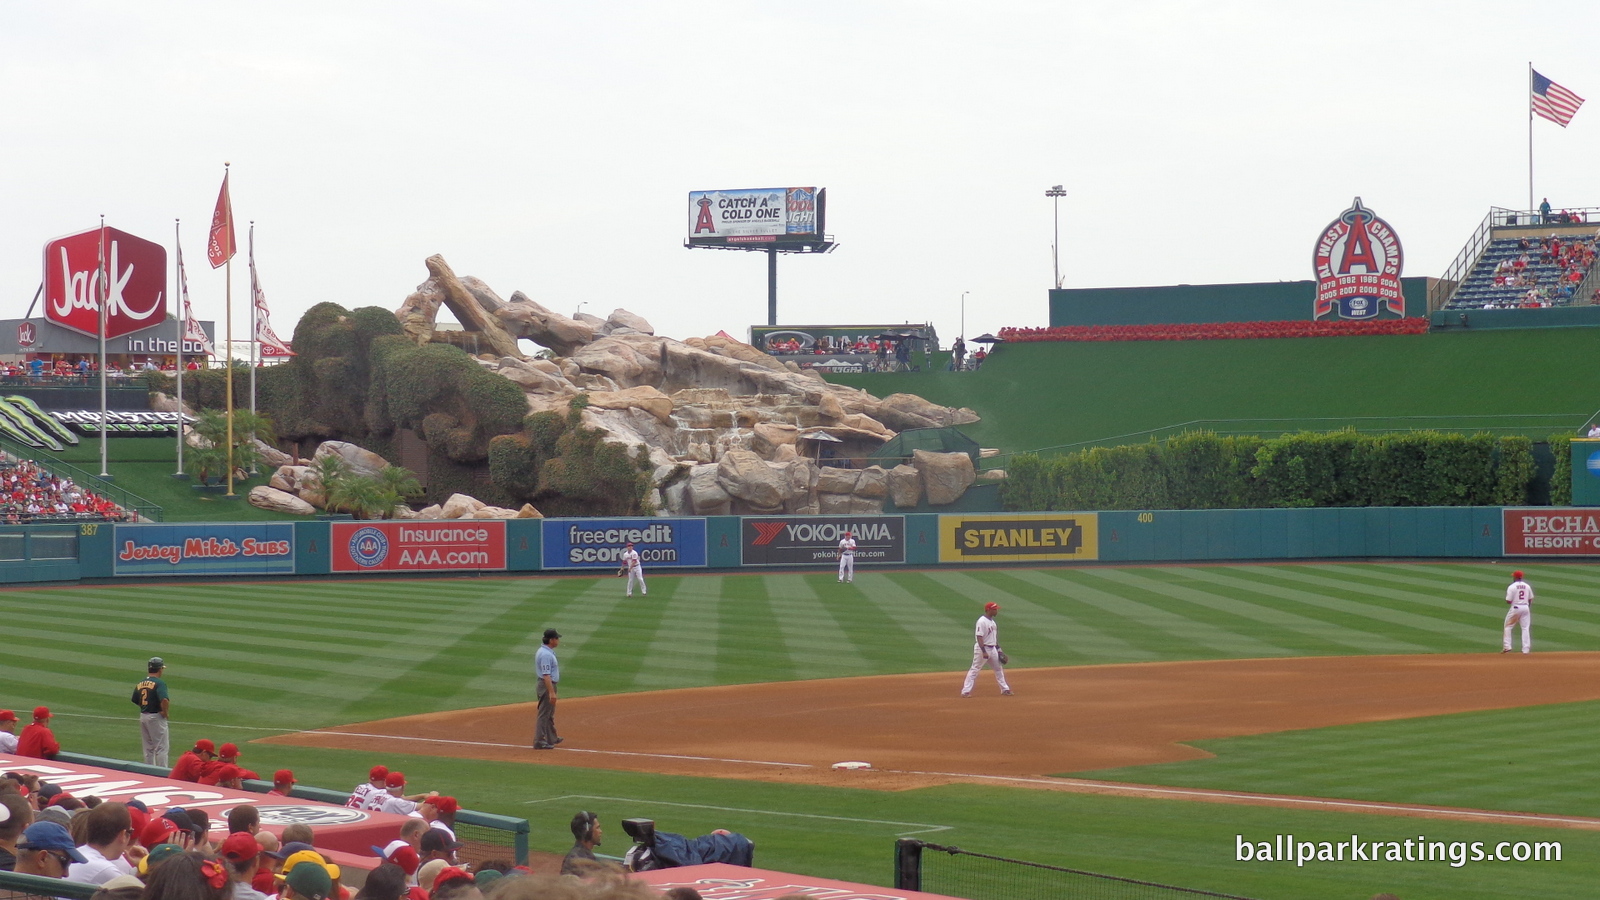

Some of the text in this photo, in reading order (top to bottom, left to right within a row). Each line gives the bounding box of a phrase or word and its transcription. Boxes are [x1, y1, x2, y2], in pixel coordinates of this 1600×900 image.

[718, 197, 768, 209] CATCH A
[722, 208, 780, 220] COLD ONE
[1318, 223, 1343, 279] AL WEST
[1371, 222, 1399, 275] CHAMPS
[53, 240, 162, 320] Jack
[1381, 278, 1398, 289] 2004
[1320, 289, 1337, 301] 2005
[1339, 286, 1357, 296] 2007
[1380, 287, 1398, 298] 2009
[129, 336, 214, 353] in the bo
[51, 409, 198, 423] MONSTER
[1137, 513, 1153, 523] 400
[81, 524, 99, 536] 387
[399, 526, 488, 542] Insurance
[569, 524, 672, 544] freecredit
[786, 523, 892, 541] YOKOHAMA
[963, 527, 1073, 548] STANLEY
[360, 540, 378, 551] AAA
[1524, 536, 1583, 548] RESORT
[120, 540, 182, 564] Jersey
[184, 537, 239, 560] Mike's
[399, 549, 488, 565] AAA.com
[1518, 590, 1525, 600] 2
[141, 689, 149, 706] 2
